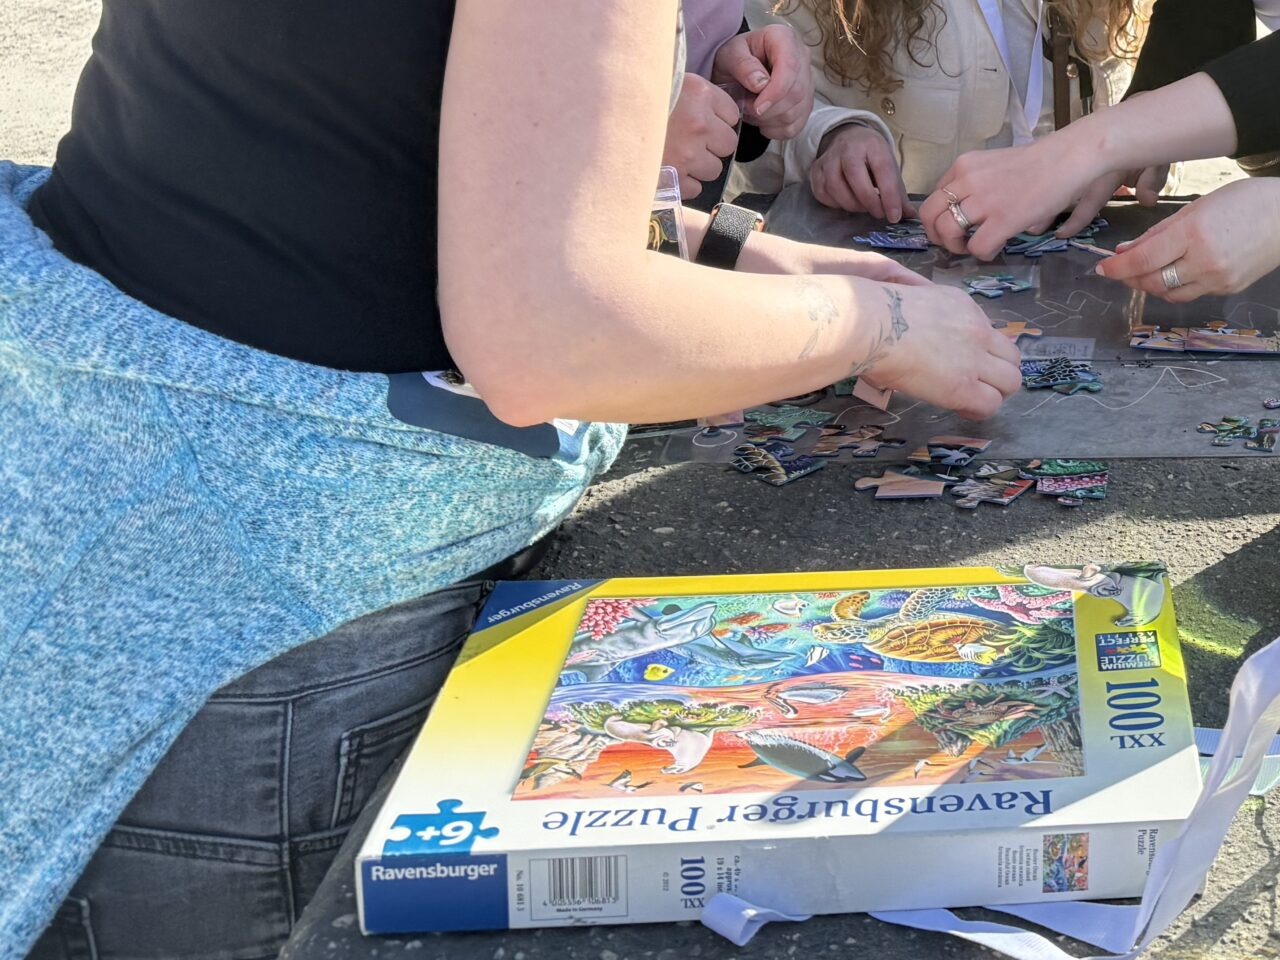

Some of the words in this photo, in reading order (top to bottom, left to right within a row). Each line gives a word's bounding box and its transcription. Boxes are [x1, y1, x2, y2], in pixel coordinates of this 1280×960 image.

[487, 582, 582, 624] Ravensburger
[1098, 635, 1156, 646] PERFECT
[1100, 653, 1158, 664] PUZZLE
[1100, 659, 1159, 670] PREMIUM
[1106, 677, 1164, 731] 100
[1110, 732, 1166, 750] XXL
[716, 789, 1053, 824] Ravensburger
[415, 820, 474, 846] 6+
[542, 806, 702, 836] Puzzle
[1137, 829, 1147, 855] Puzzle
[371, 862, 497, 881] Ravensburger
[680, 856, 705, 896] 100
[680, 897, 705, 909] XXL
